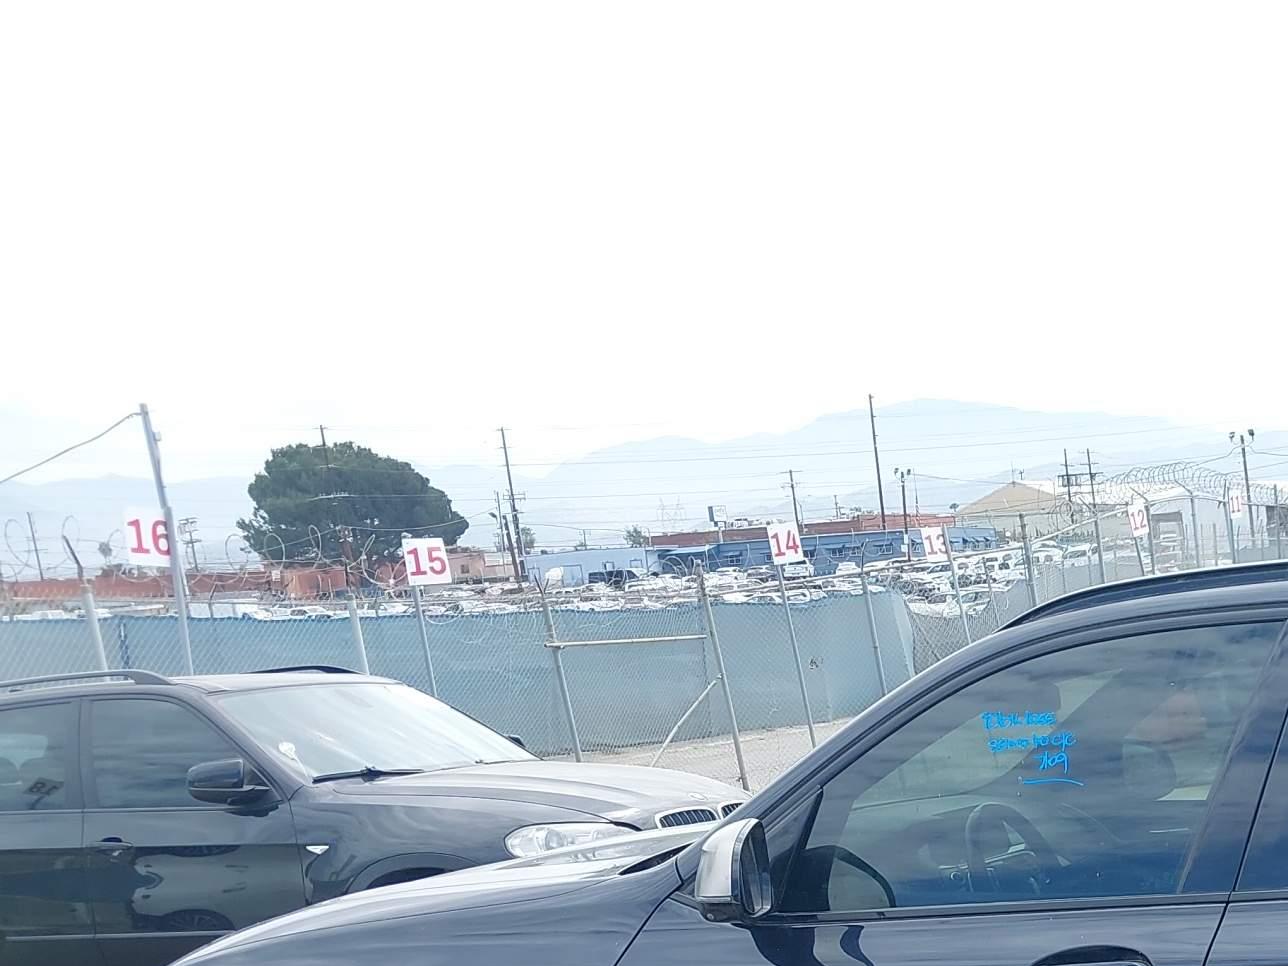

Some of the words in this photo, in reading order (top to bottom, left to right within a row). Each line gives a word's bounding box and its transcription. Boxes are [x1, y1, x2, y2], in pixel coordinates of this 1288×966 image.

[1130, 509, 1147, 530] 12
[127, 518, 171, 556] 16
[770, 530, 800, 557] 14
[924, 534, 948, 555] 13
[406, 547, 447, 576] 15
